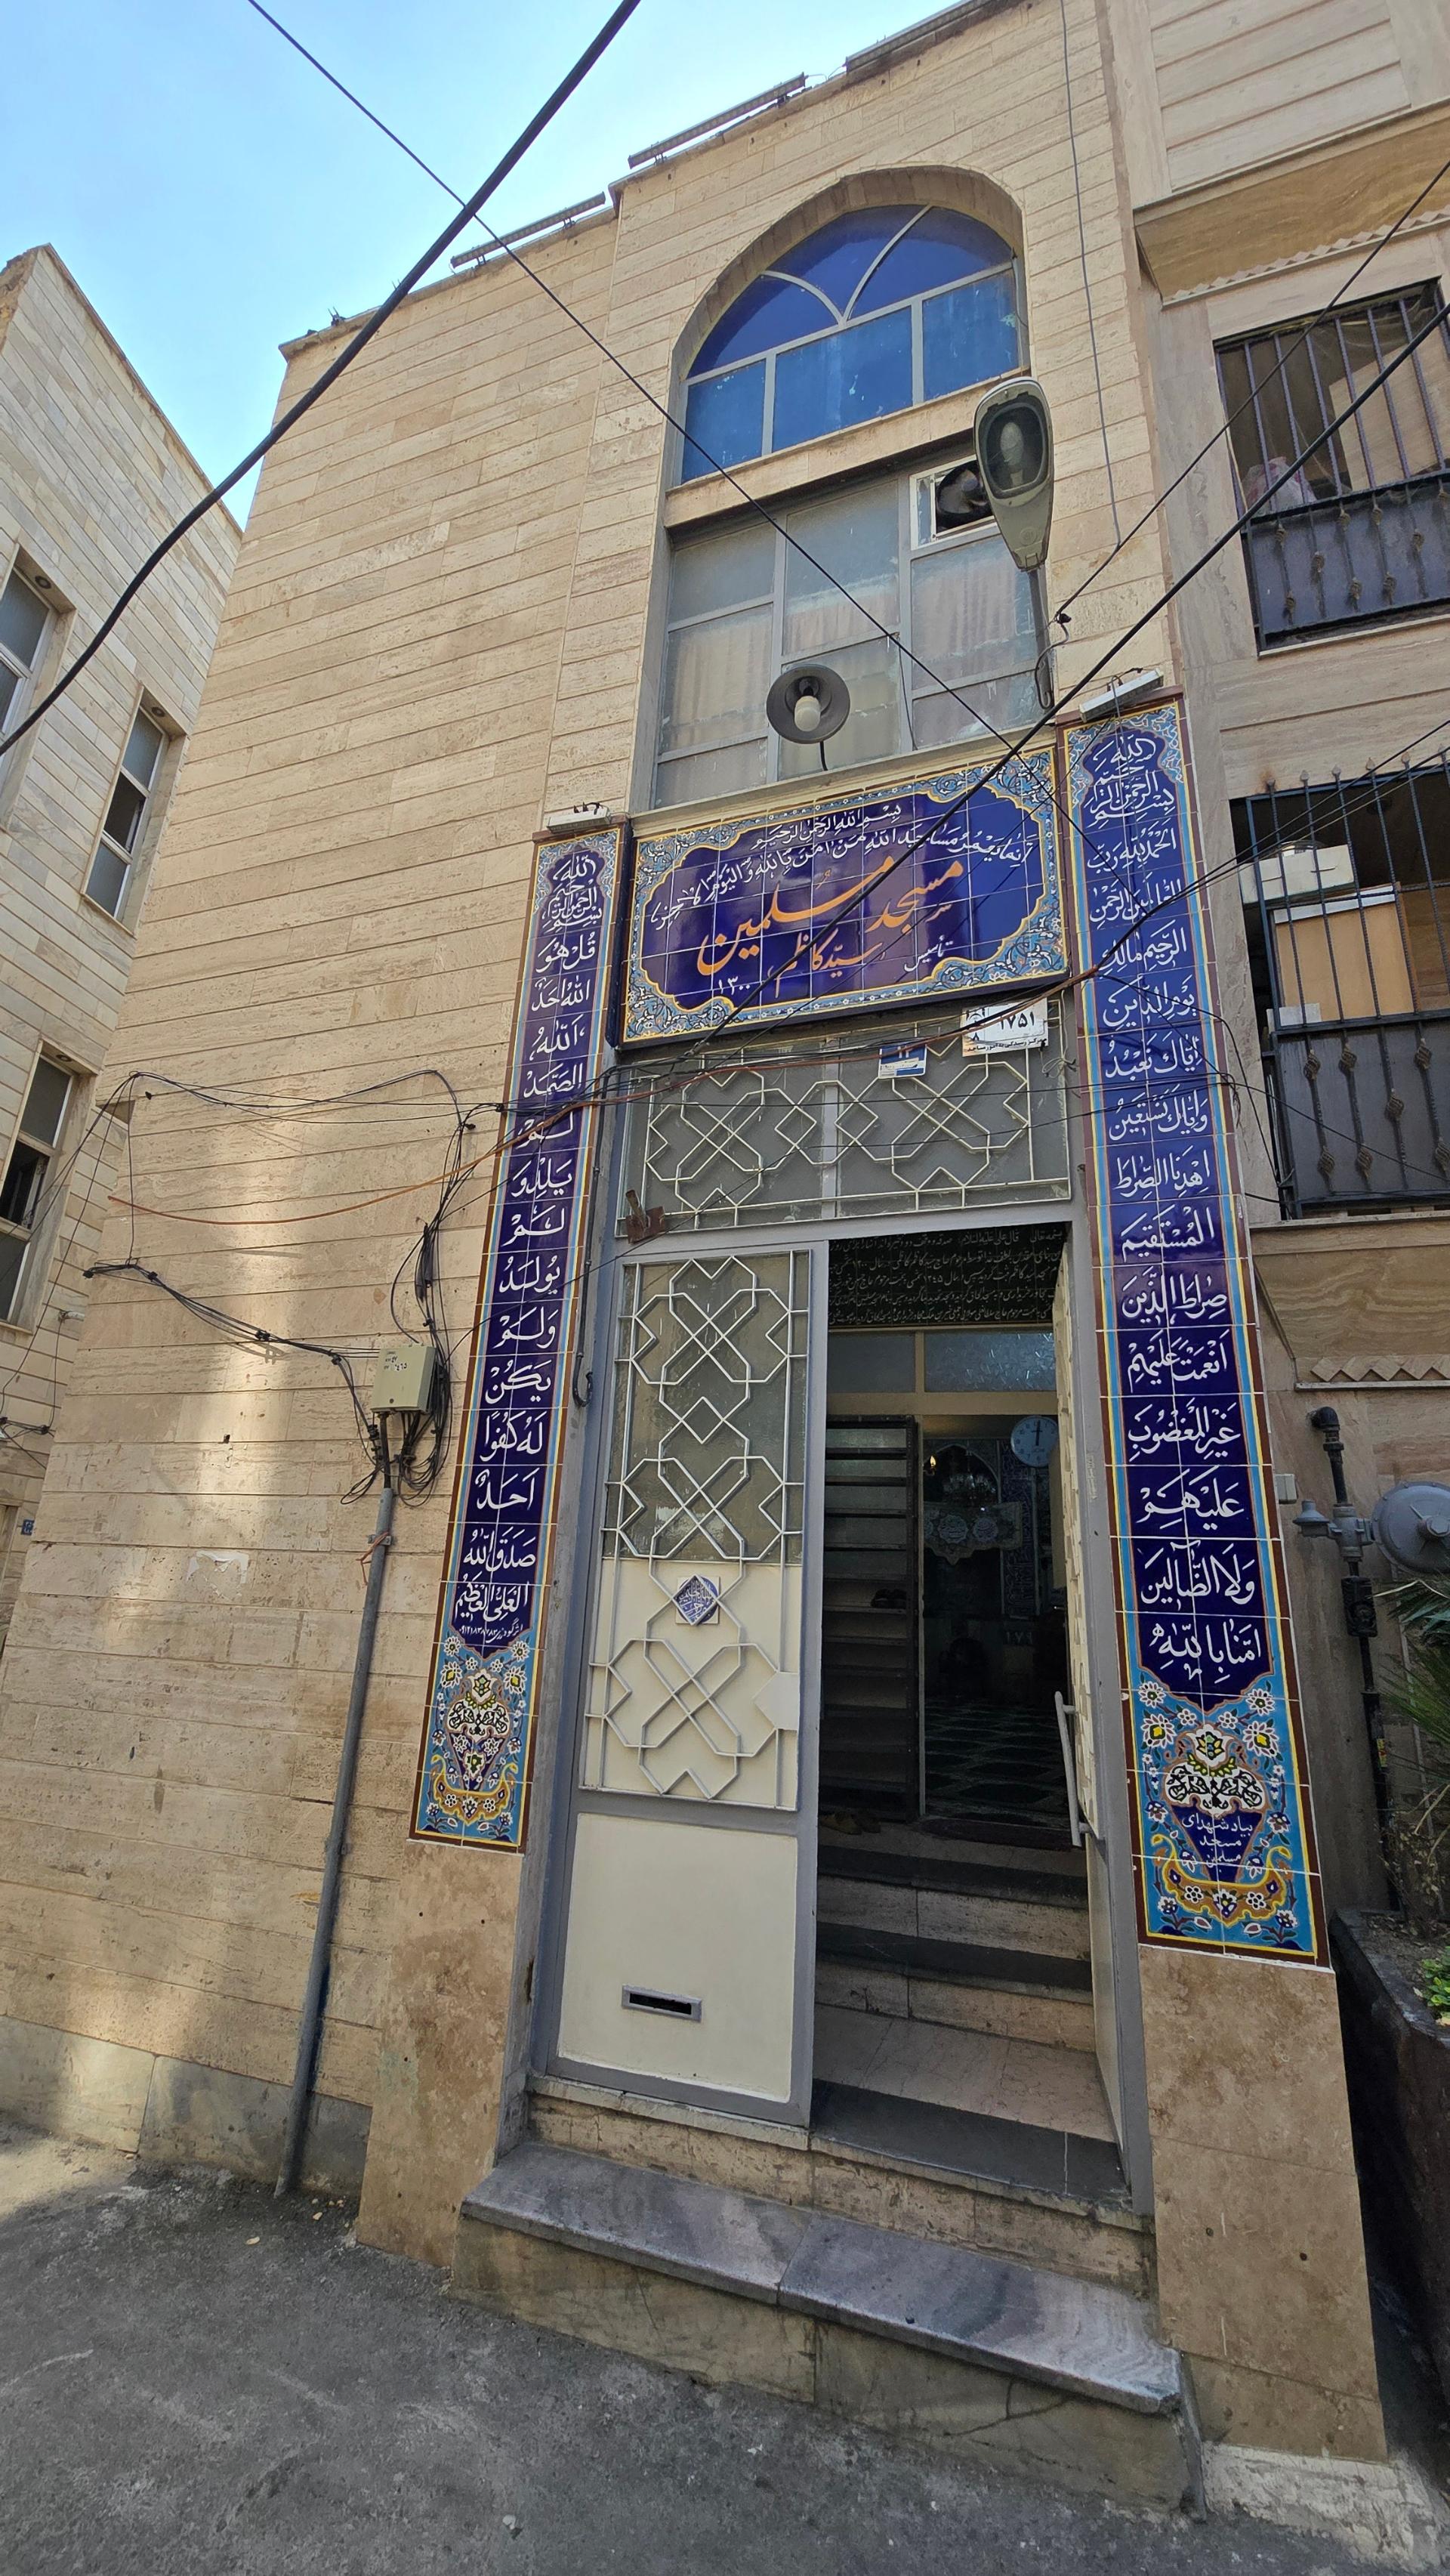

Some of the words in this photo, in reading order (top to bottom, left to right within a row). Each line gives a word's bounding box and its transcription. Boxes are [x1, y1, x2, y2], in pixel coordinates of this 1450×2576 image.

[865, 860, 964, 934] مسجد
[696, 854, 896, 977] مسلمین
[1181, 1813, 1229, 1834] شهدای
[1231, 1815, 1254, 1838] بیاد
[1200, 1836, 1242, 1851] مسجد
[1205, 1849, 1242, 1873] مسلمین
